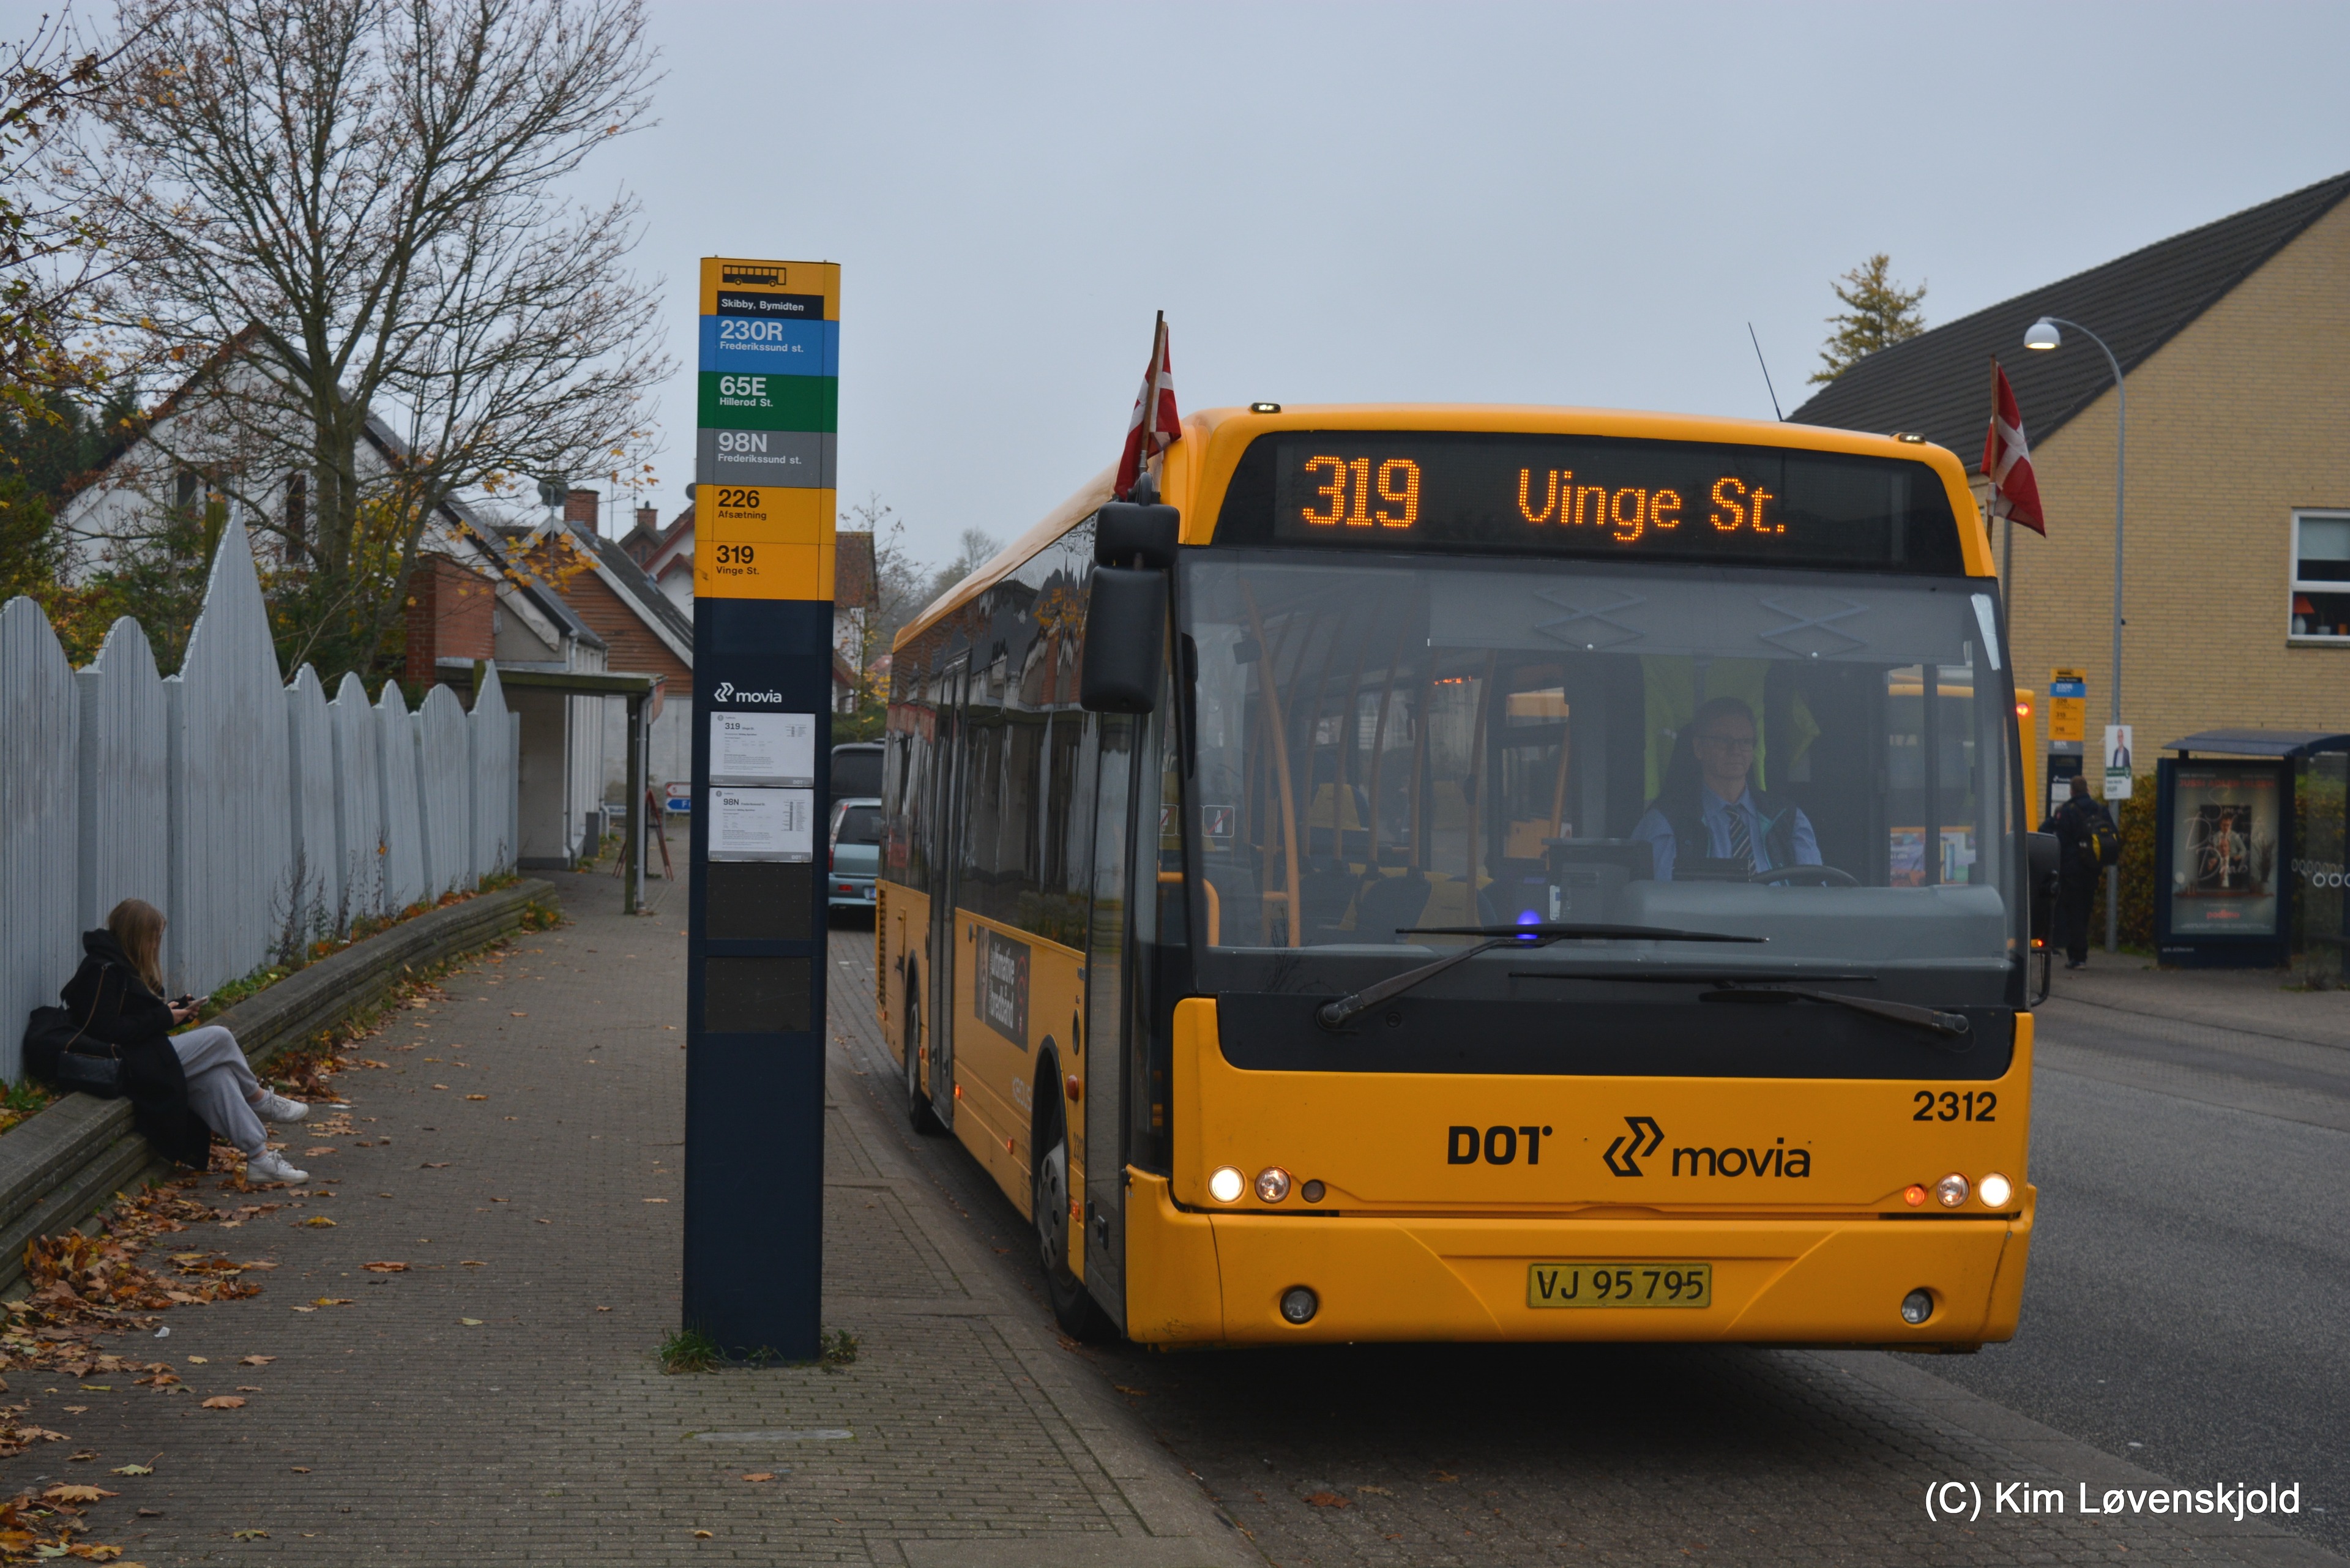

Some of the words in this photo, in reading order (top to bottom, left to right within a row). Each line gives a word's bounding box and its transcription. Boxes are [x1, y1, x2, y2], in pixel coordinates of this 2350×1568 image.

[722, 299, 756, 310] Skibby,
[759, 301, 804, 312] Bymidten
[720, 319, 783, 341] 230R
[720, 341, 788, 352] Frederikssund
[791, 345, 804, 353] st.
[720, 376, 767, 397] 65E
[720, 397, 756, 406] Hillerød
[759, 398, 774, 407] St.
[718, 432, 767, 452] 98N
[718, 454, 786, 464] Frederikssund
[789, 456, 802, 465] st.
[718, 488, 760, 509] 226
[1302, 455, 1420, 529] 319
[1518, 468, 1682, 542] Vinge
[1709, 477, 1786, 534] St.
[718, 510, 767, 521] Afsætning
[716, 545, 755, 564] 319
[716, 566, 744, 576] Vinge
[736, 689, 782, 703] movia
[1912, 1090, 1997, 1122] 2312
[1447, 1125, 1553, 1166] DOT
[1672, 1138, 1811, 1178] movia
[1536, 1270, 1580, 1300] VJ
[1592, 1270, 1633, 1301] 95
[1642, 1270, 1705, 1301] 795
